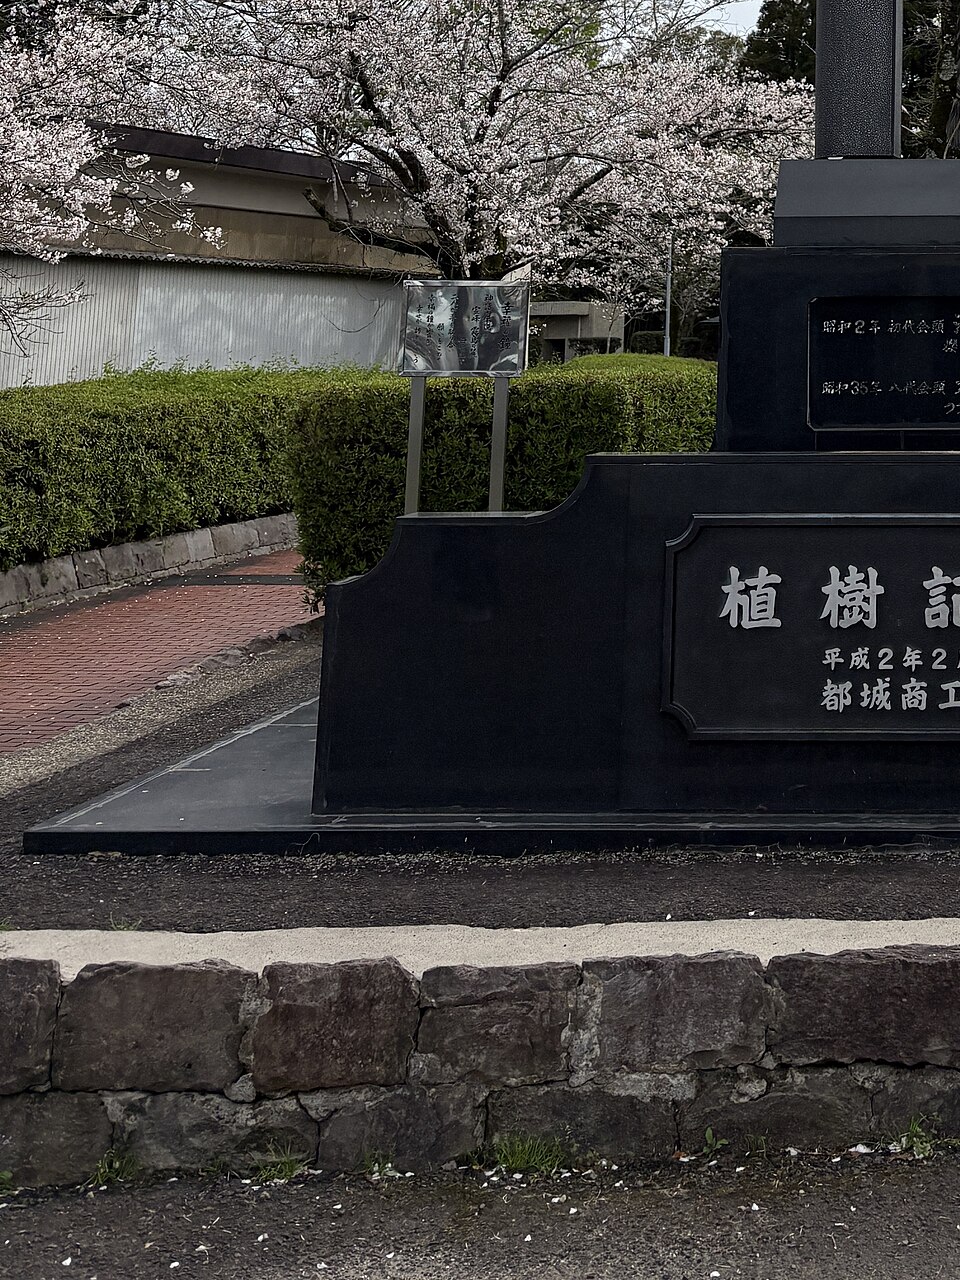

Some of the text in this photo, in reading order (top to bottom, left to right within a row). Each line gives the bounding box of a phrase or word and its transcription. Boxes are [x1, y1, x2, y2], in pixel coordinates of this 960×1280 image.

[822, 319, 881, 335] 昭和2年
[821, 380, 882, 396] 昭和35年
